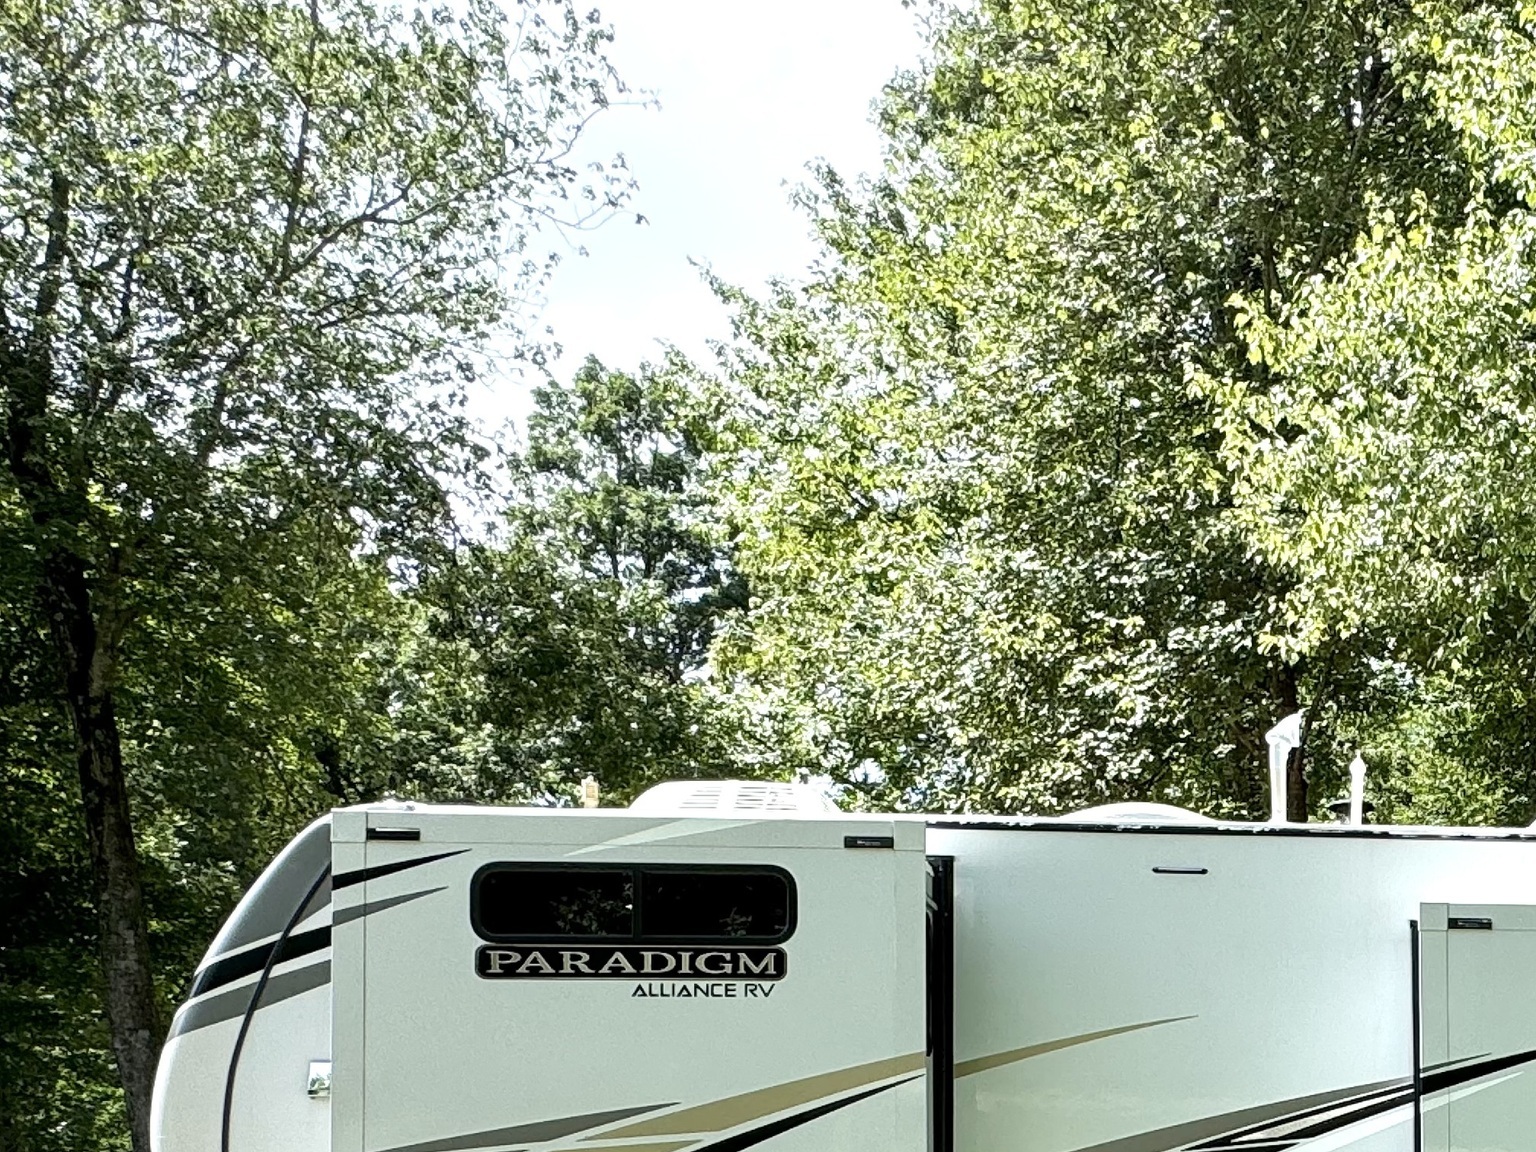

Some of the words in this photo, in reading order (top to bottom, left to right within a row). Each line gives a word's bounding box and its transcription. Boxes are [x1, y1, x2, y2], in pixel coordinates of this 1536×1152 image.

[485, 950, 777, 974] PARADIGM
[632, 983, 737, 997] ALLIANCE
[744, 984, 775, 997] RV
